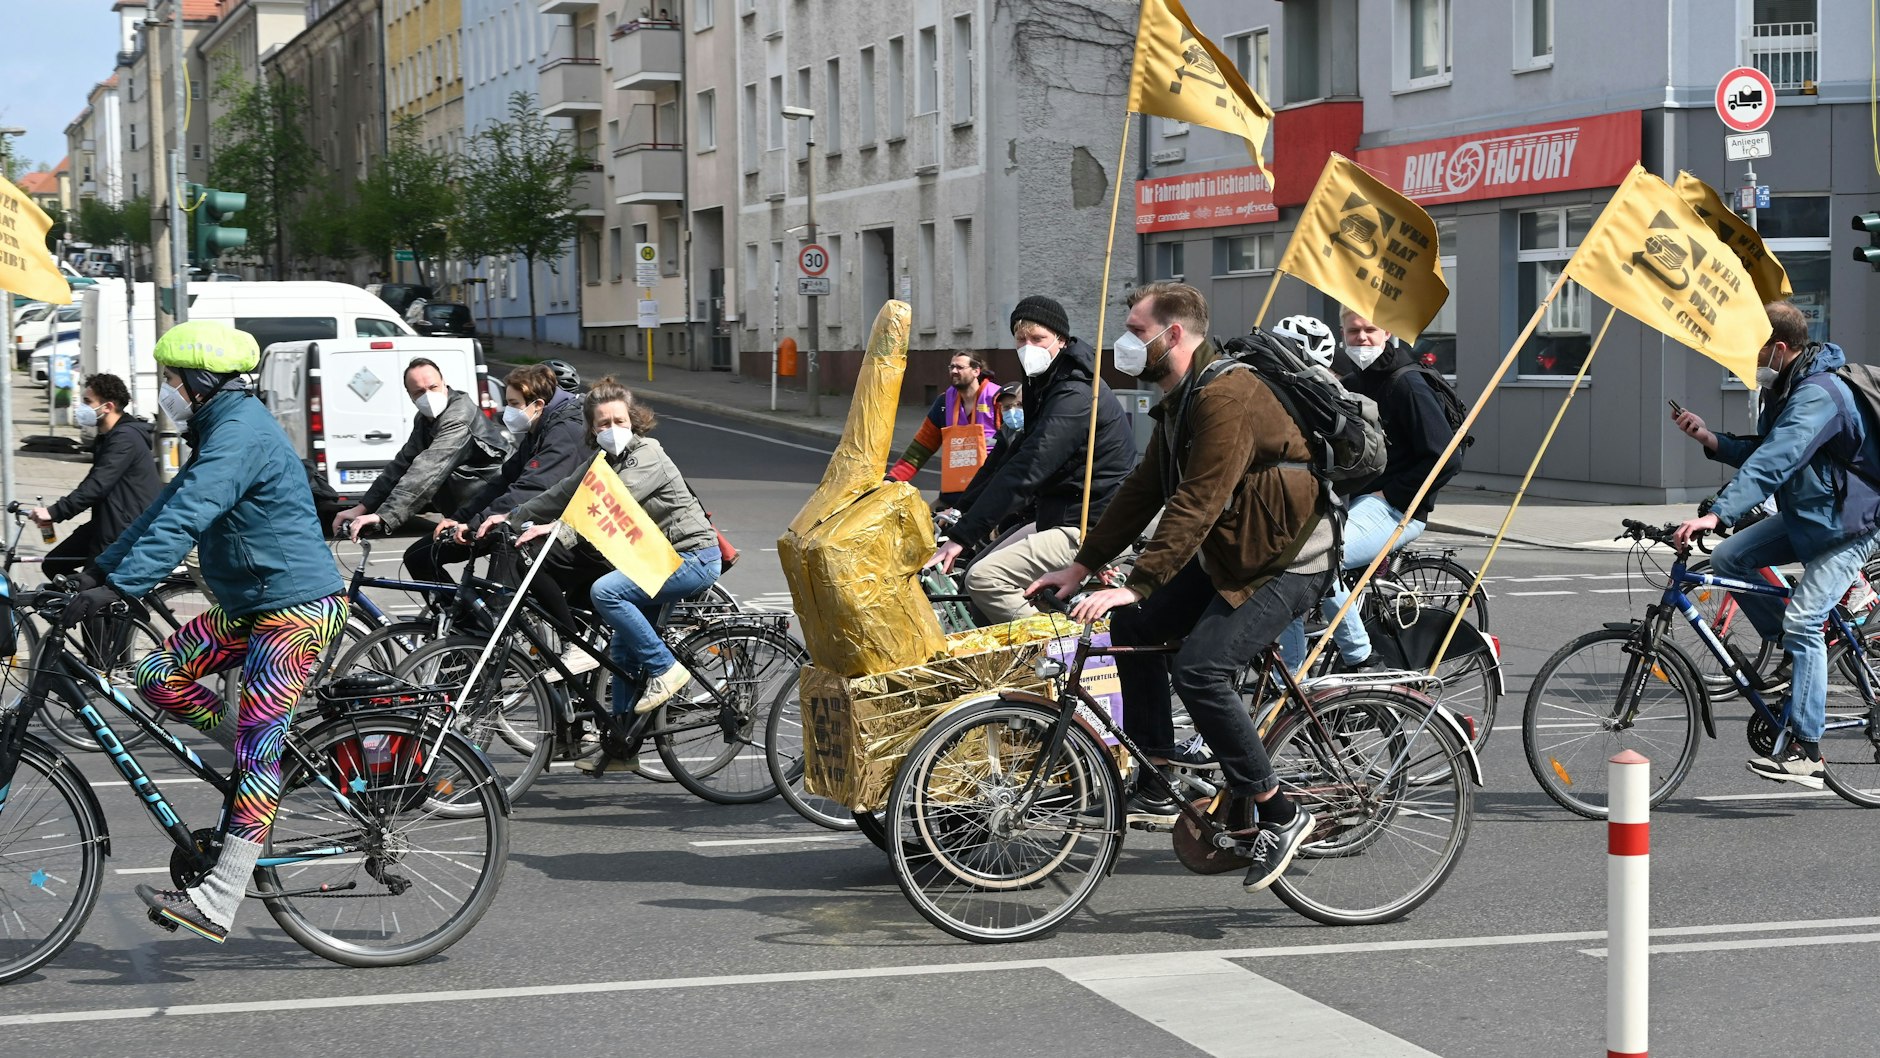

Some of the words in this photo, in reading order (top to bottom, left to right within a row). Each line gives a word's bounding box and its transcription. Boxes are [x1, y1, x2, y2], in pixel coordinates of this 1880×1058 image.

[1732, 137, 1764, 148] Anlieger
[1402, 151, 1446, 196] BIKE
[1484, 132, 1580, 186] FACTORY
[1142, 185, 1154, 205] Ihr
[1155, 177, 1205, 203] Fahrradprofi
[1207, 177, 1216, 197] in
[0, 211, 16, 231] AT
[1399, 220, 1430, 250] WER
[804, 253, 823, 268] 30
[1386, 238, 1418, 263] HAT
[1377, 256, 1407, 281] DER
[1711, 256, 1741, 293] WER
[1370, 275, 1402, 301] GIBT
[1697, 272, 1730, 307] HAT
[1688, 289, 1718, 326] DER
[1675, 310, 1712, 345] GIBT
[582, 470, 644, 546] ORDNER
[79, 704, 180, 829] FOCUS
